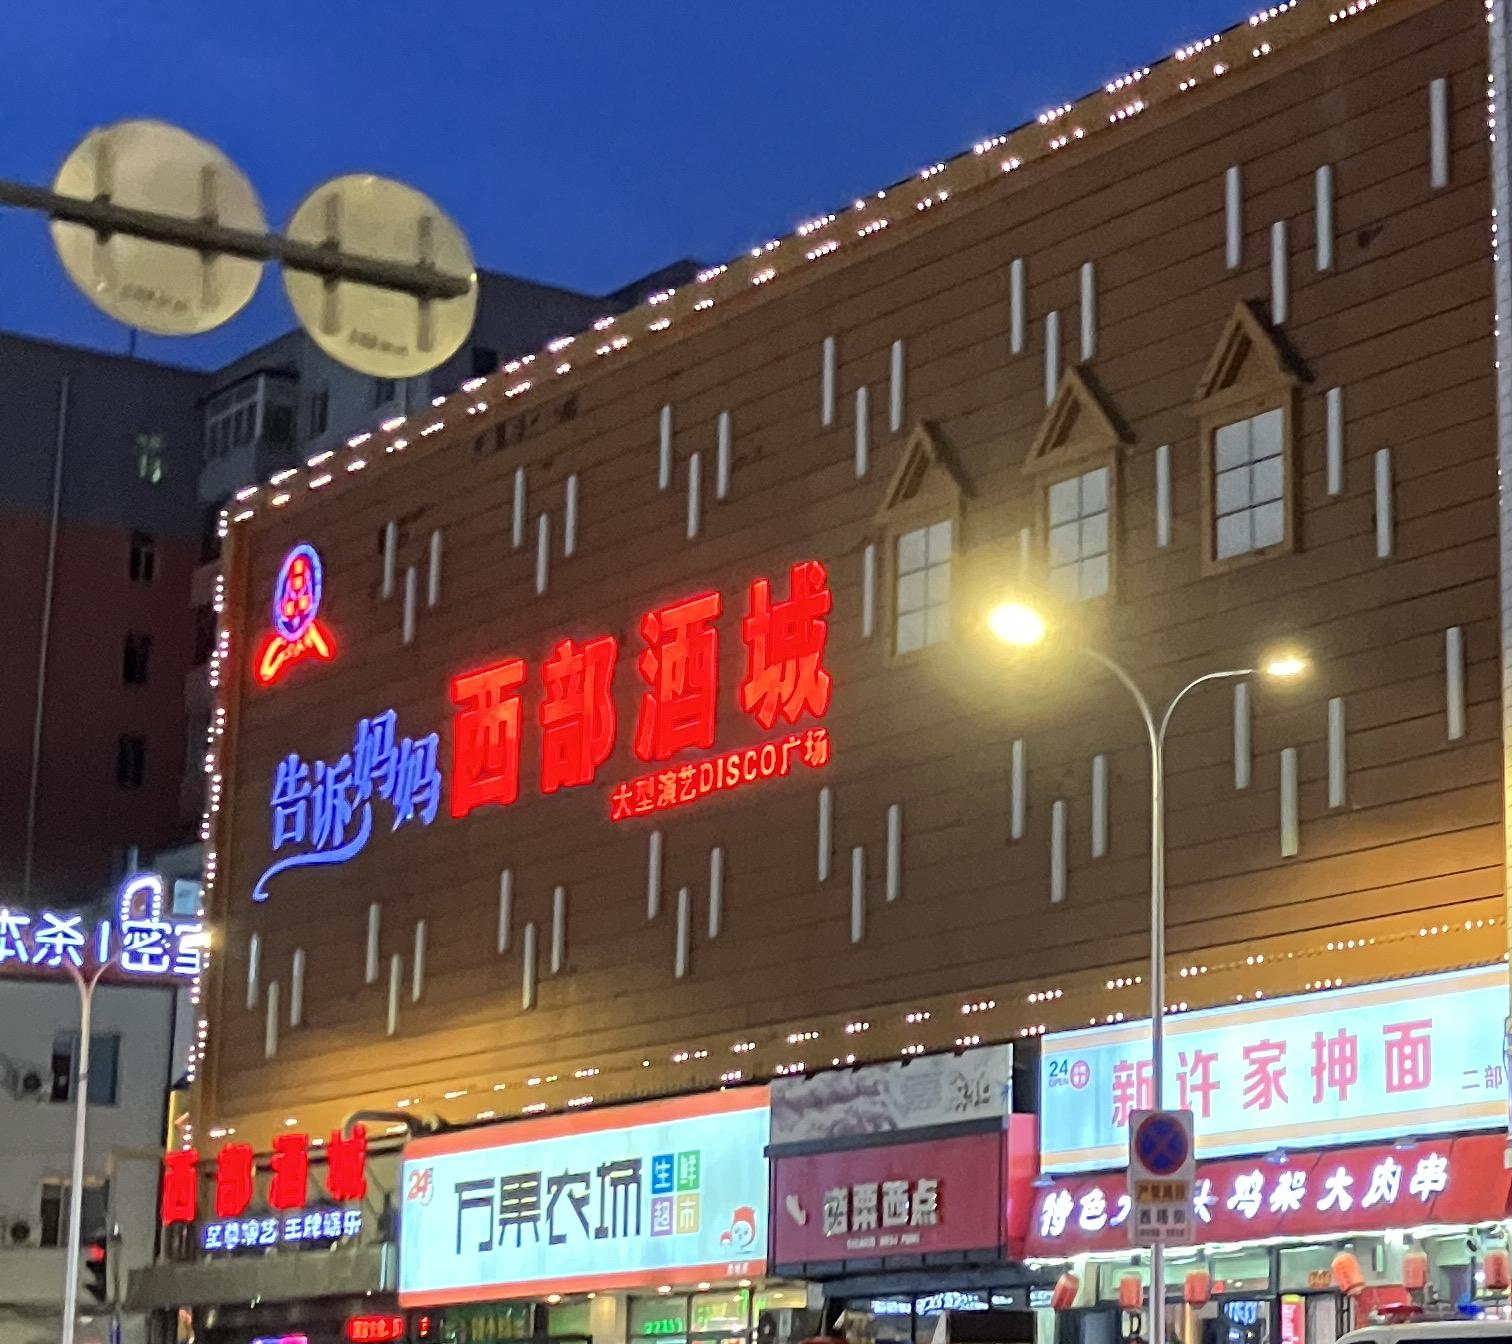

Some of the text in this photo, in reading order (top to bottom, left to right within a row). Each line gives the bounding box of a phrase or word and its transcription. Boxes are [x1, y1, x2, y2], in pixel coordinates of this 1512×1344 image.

[450, 560, 832, 819] 西部酒城
[270, 708, 442, 851] 告诉妈妈
[611, 727, 830, 822] 大型演艺DISCO广场
[1049, 1058, 1069, 1078] 24
[1111, 1018, 1433, 1128] 新许家抻面
[1462, 1064, 1503, 1090] 二部
[454, 1156, 644, 1255] 万果农场
[652, 1154, 699, 1192] 生鲜
[652, 1196, 698, 1238] 超市
